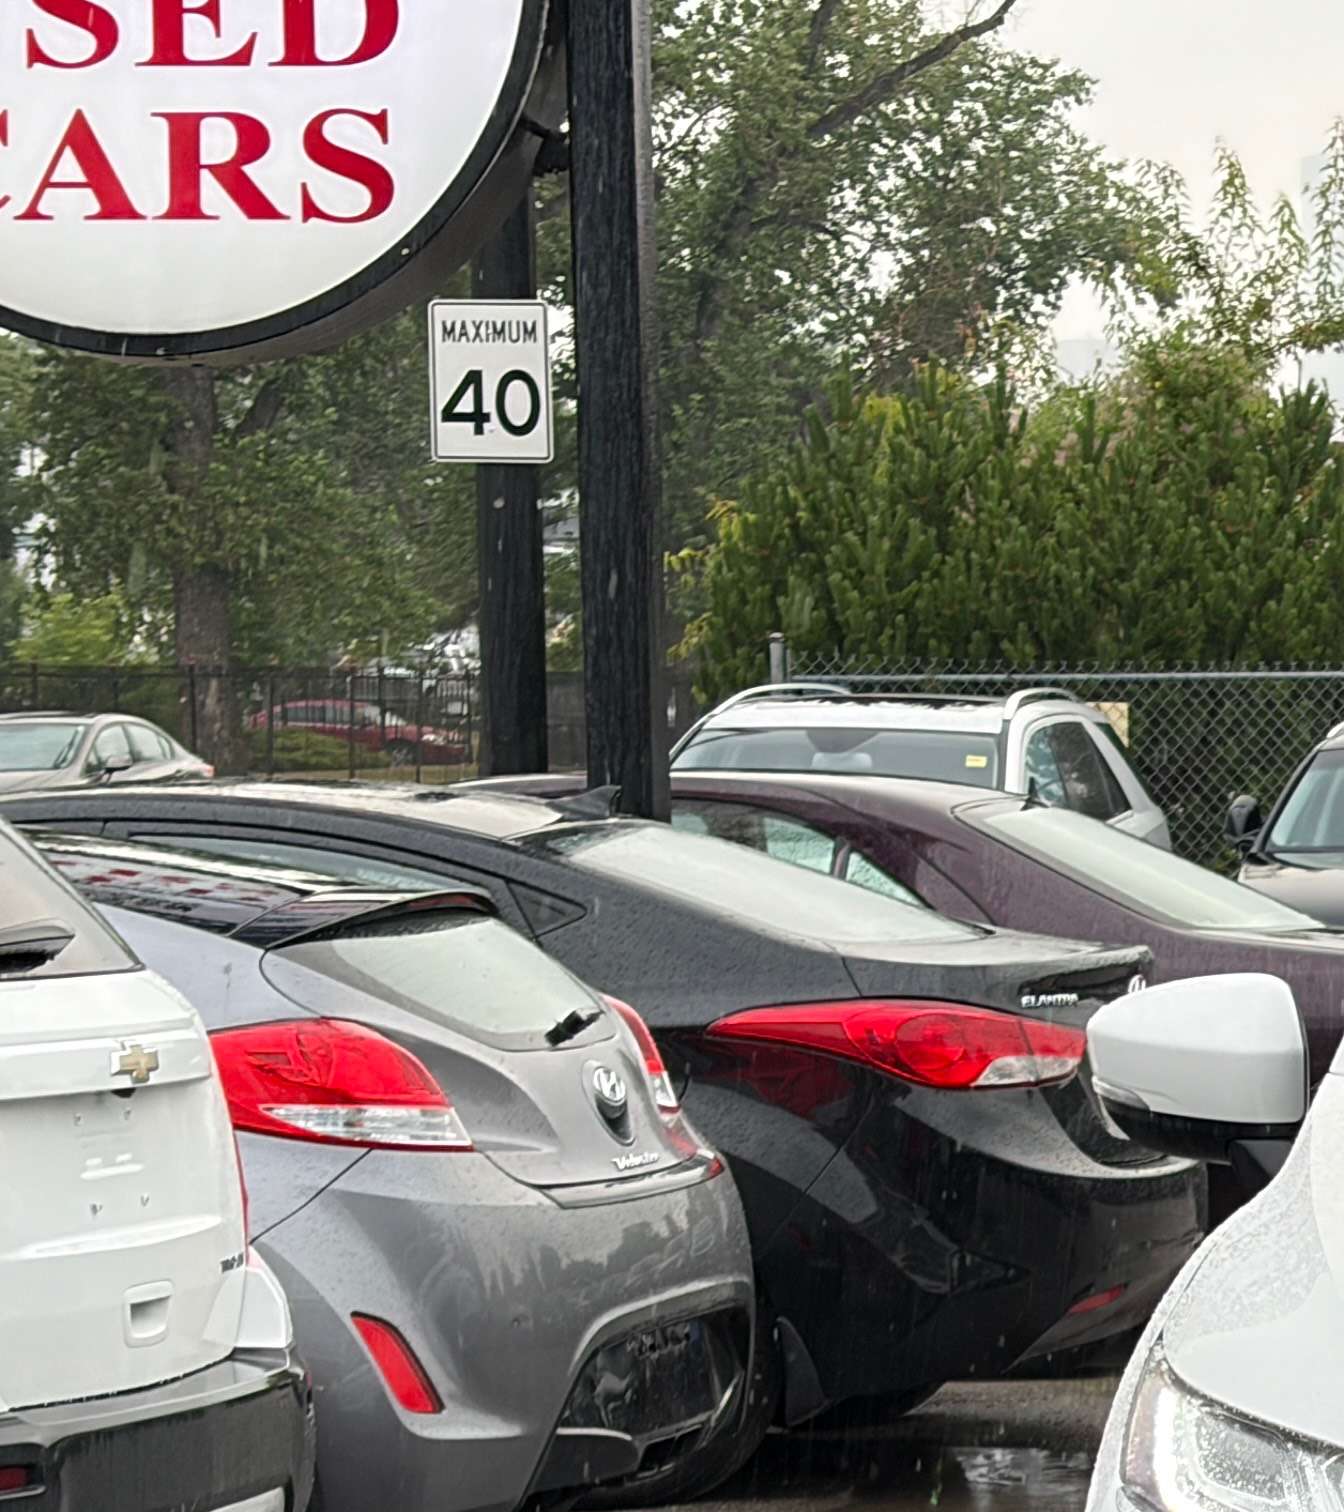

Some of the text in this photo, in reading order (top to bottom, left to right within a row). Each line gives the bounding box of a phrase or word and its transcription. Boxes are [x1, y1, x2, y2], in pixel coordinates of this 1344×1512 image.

[0, 108, 395, 224] ARS
[441, 319, 538, 344] MAXIMUM
[441, 369, 540, 437] 40
